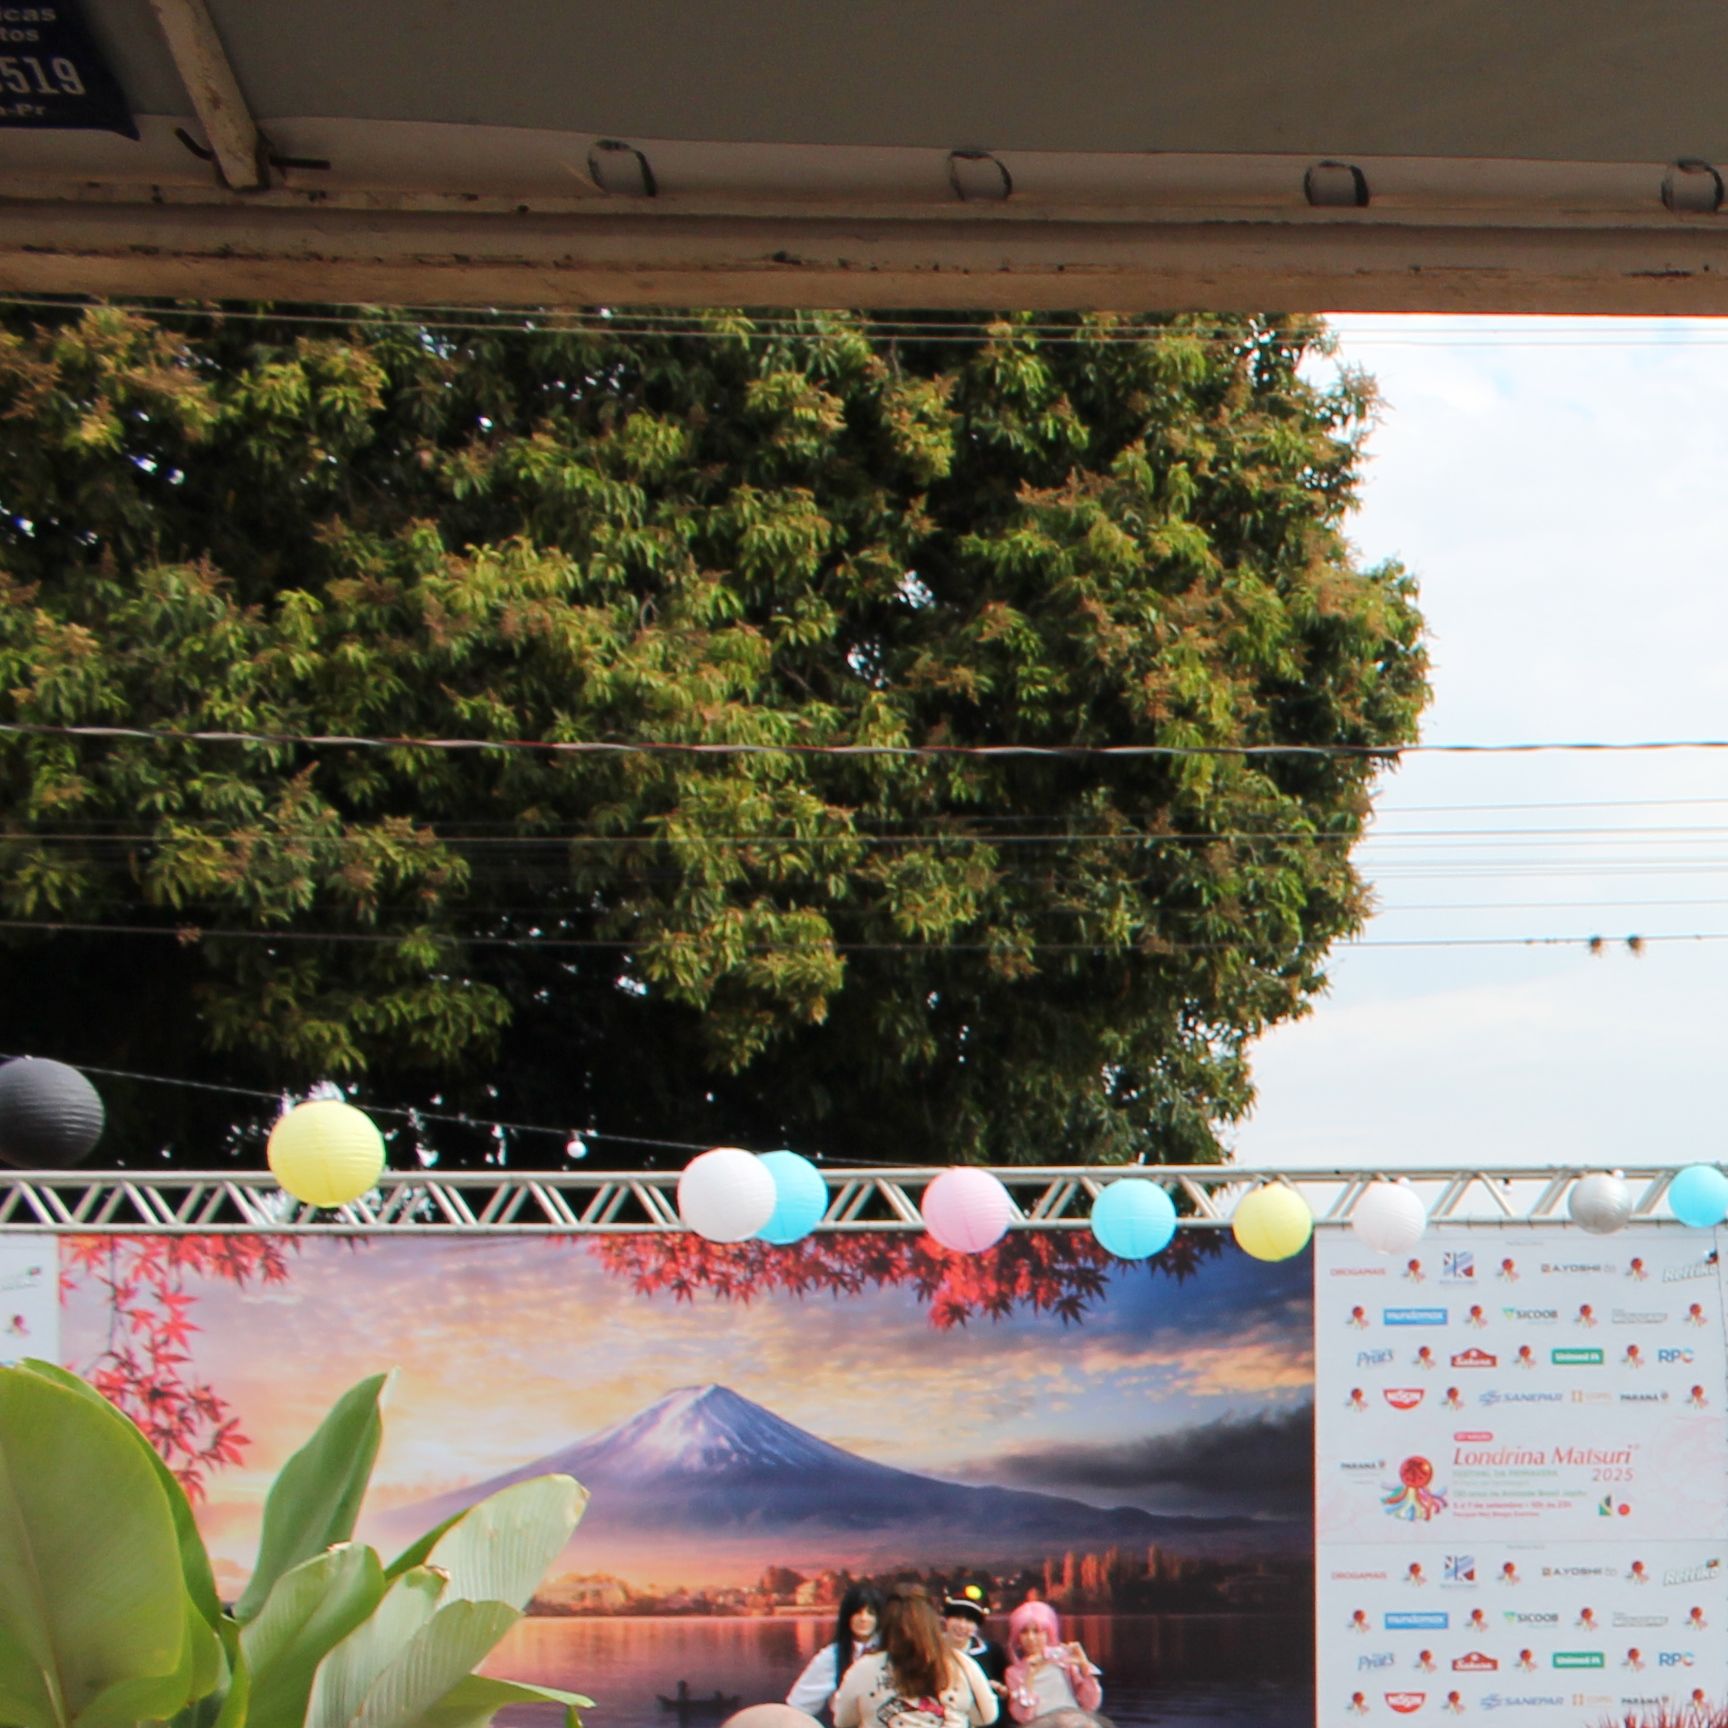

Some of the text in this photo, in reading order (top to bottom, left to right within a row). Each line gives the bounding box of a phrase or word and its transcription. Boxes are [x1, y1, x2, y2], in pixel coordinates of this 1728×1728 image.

[1516, 1310, 1558, 1319] SICOOB
[1658, 1349, 1694, 1364] RPC
[1503, 1392, 1563, 1402] SANEPAR
[1453, 1444, 1633, 1466] Londrina Matsuri
[1592, 1468, 1634, 1482] 2025
[1517, 1613, 1559, 1623] SICOOB
[1659, 1652, 1694, 1667] RPC
[1505, 1697, 1564, 1706] SANEPAR
